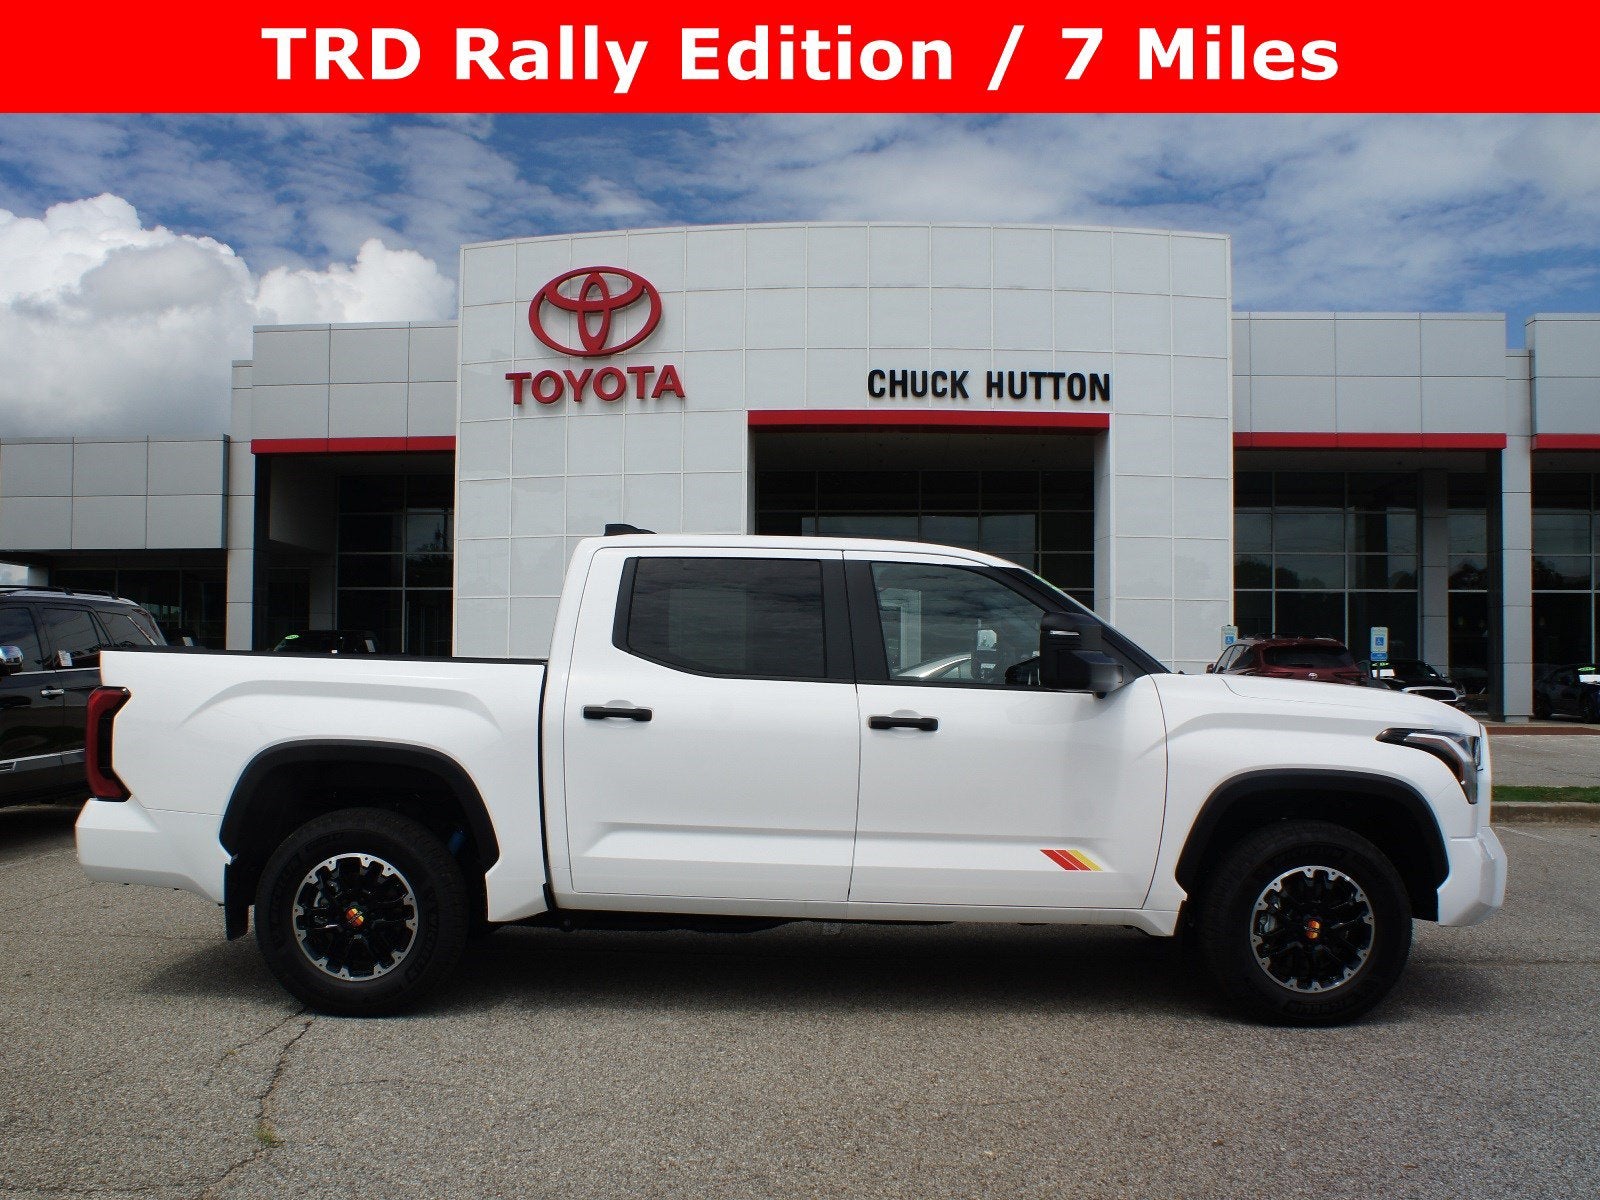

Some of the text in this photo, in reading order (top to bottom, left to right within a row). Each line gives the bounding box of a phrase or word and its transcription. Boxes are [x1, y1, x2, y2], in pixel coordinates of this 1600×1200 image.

[506, 365, 685, 405] TOYOTA
[868, 370, 1110, 402] CHUCK HUTTON
